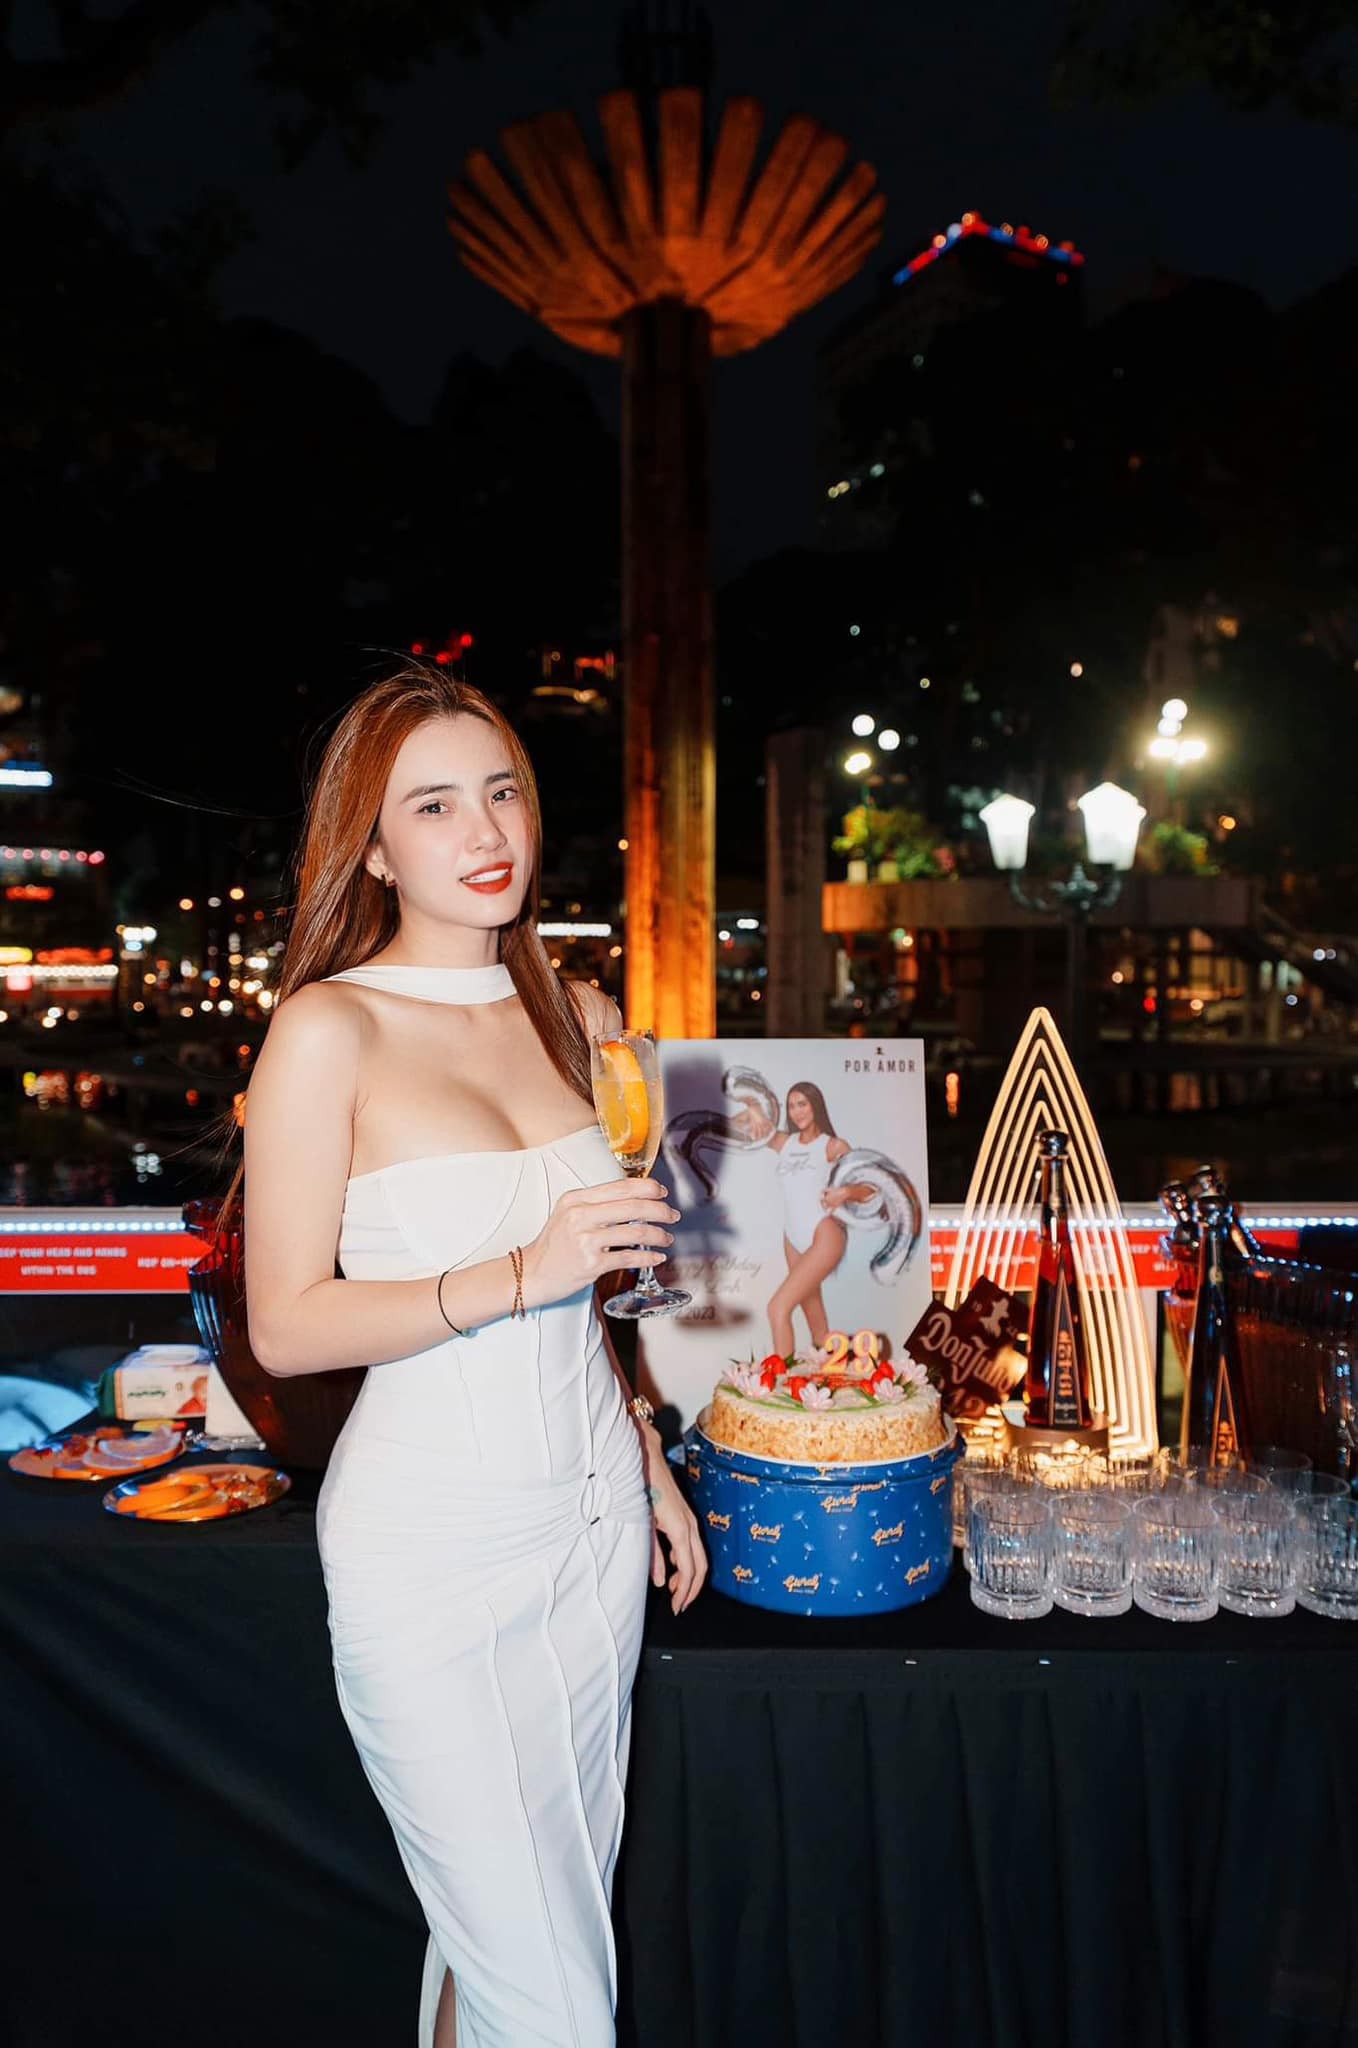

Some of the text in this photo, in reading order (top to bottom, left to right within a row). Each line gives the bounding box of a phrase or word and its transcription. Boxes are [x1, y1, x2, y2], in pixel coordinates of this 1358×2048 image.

[843, 1060, 916, 1073] POR AMOR
[0, 1247, 16, 1258] EEP
[20, 1247, 45, 1258] YOUR
[73, 1247, 93, 1258] AND
[20, 1265, 97, 1276] WITHIN THE BUS
[919, 1311, 1014, 1396] Don Julio
